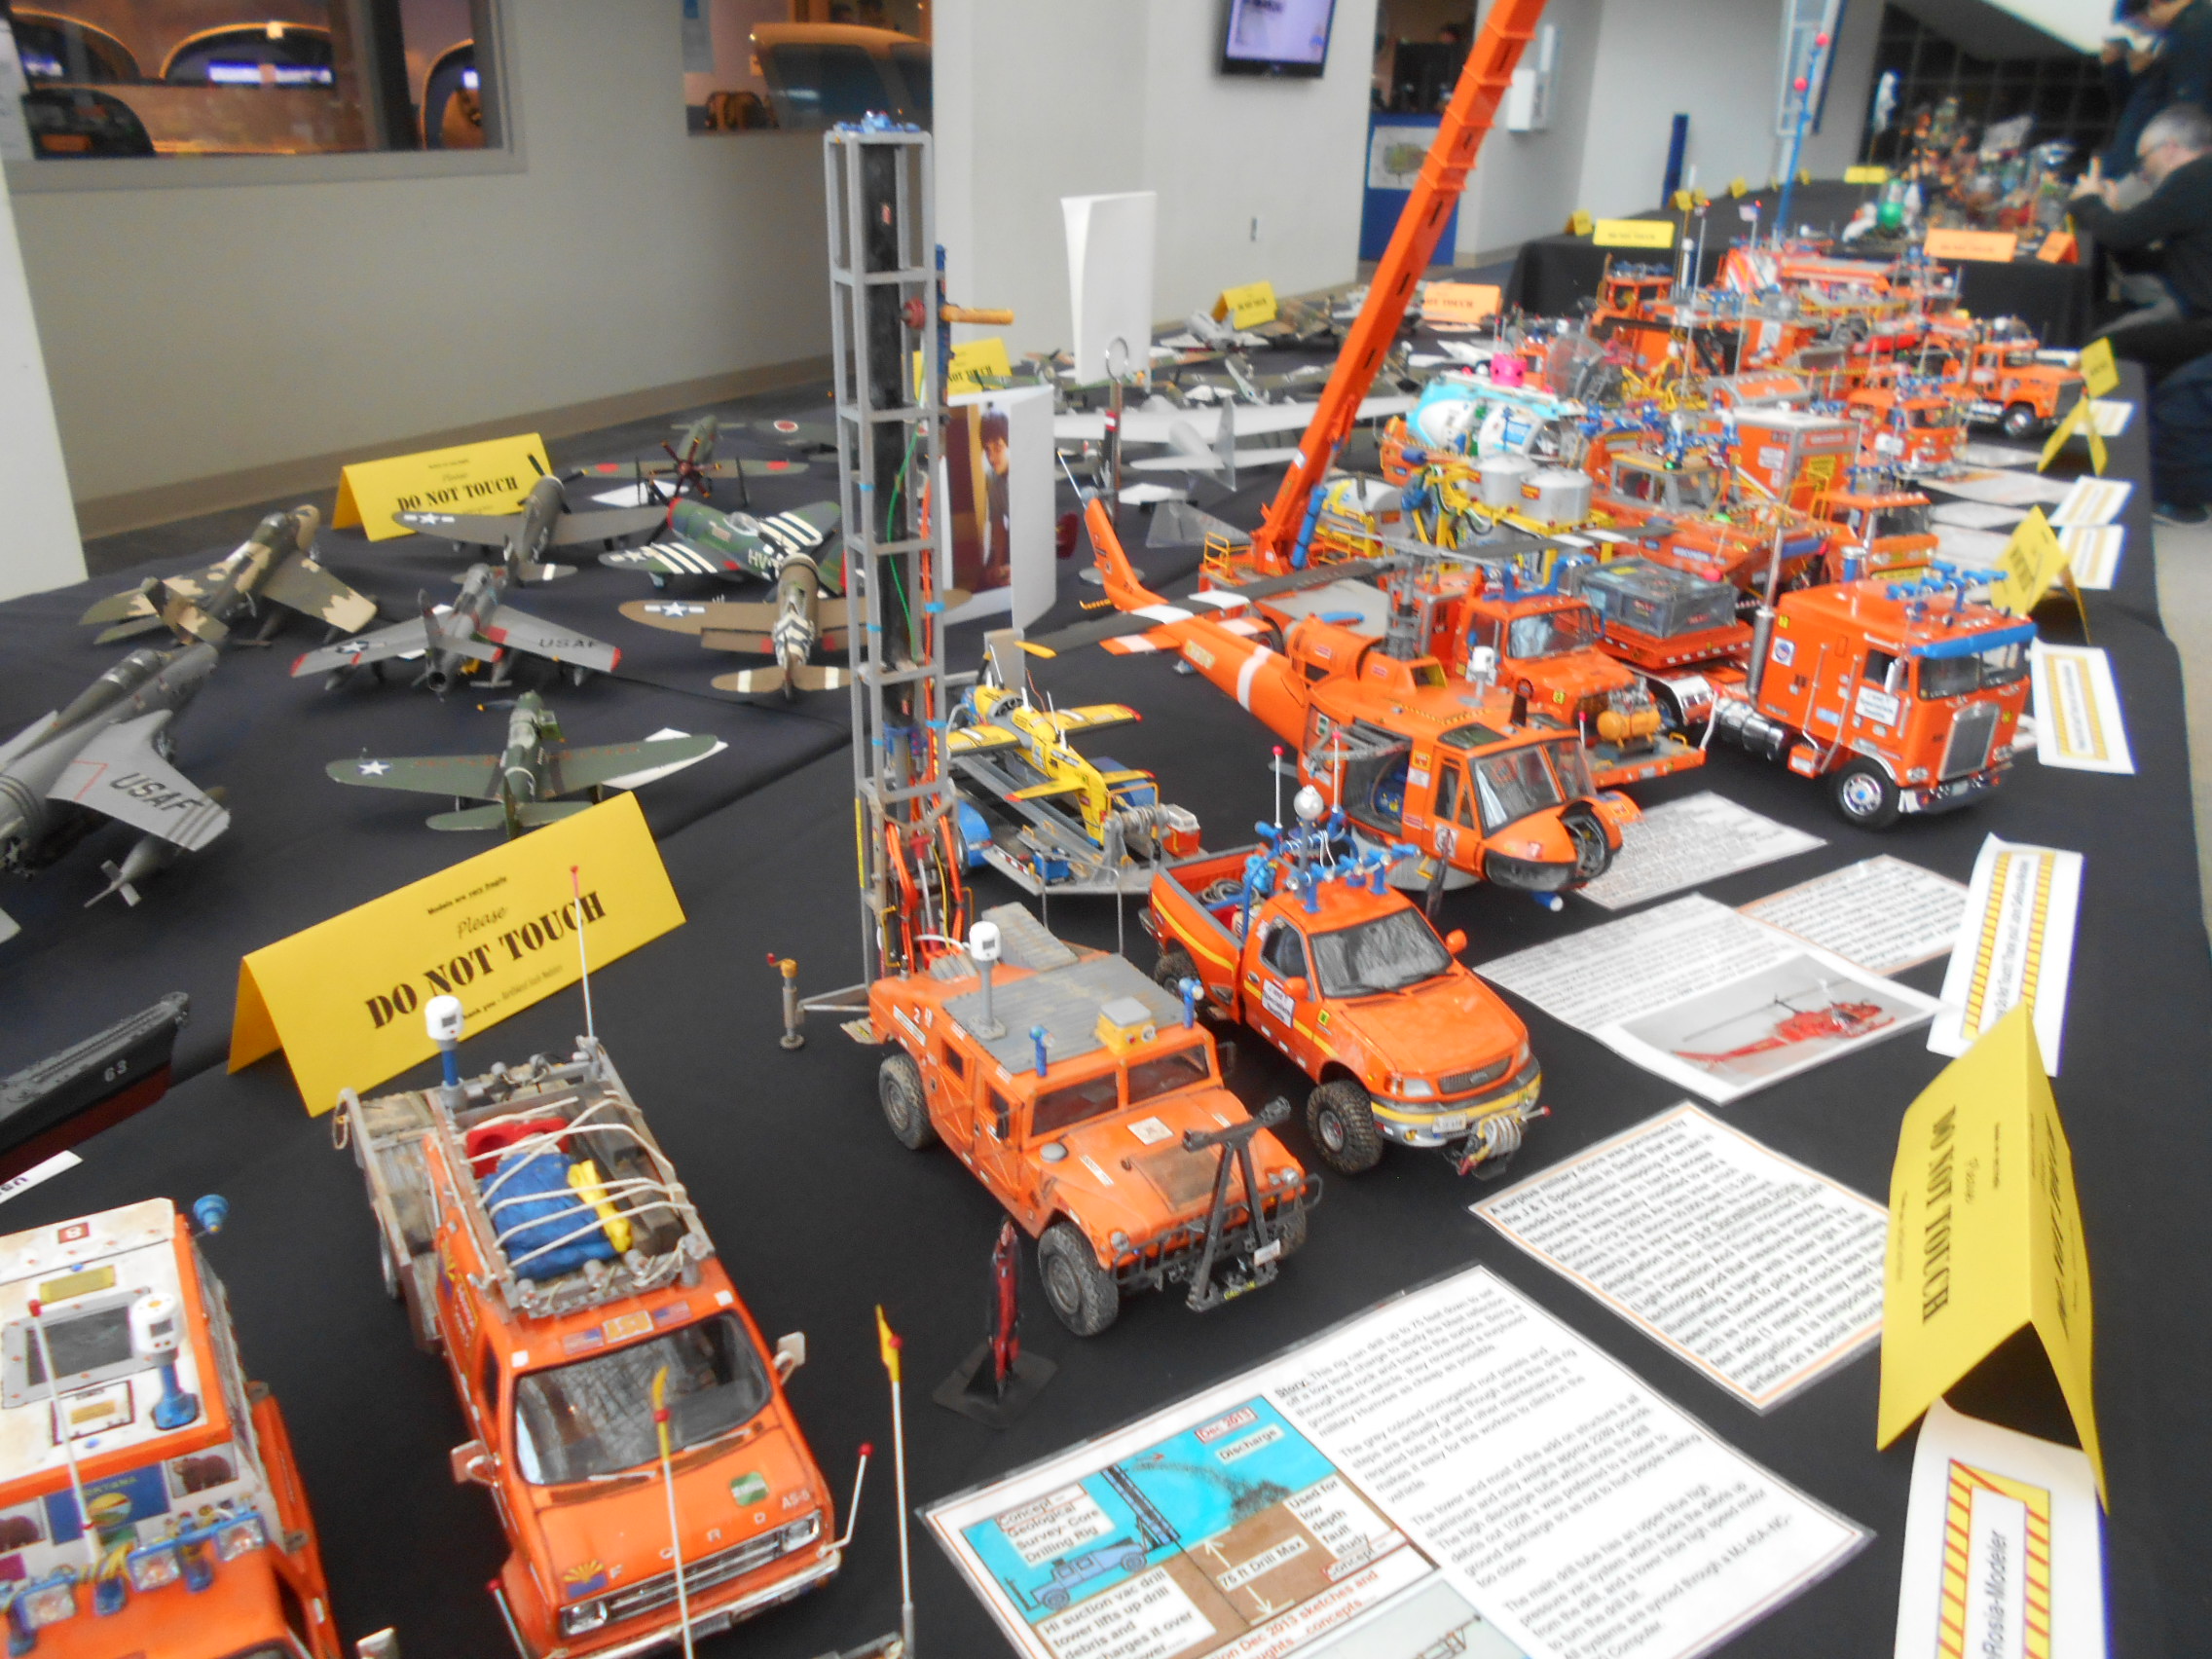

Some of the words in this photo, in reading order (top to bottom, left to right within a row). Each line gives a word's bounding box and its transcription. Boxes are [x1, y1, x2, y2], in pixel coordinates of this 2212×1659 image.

[397, 495, 421, 511] DO
[425, 488, 460, 506] NOT
[463, 476, 519, 498] TOUCH
[537, 639, 598, 650] USAF
[109, 772, 205, 811] USAF
[457, 905, 509, 940] Please
[365, 983, 419, 1029] DO
[424, 944, 494, 997] NOT
[498, 891, 607, 961] TOUCH
[104, 1059, 128, 1083] 63
[1930, 1104, 1957, 1151] DO
[1926, 1144, 1954, 1208] NOT
[1923, 1204, 1951, 1324] TOUCH
[1195, 1420, 1219, 1439] Dec
[1221, 1408, 1250, 1427] 2013
[1216, 1430, 1275, 1461] Discharge
[1288, 1489, 1320, 1508] Used
[1319, 1480, 1338, 1493] for
[1004, 1501, 1075, 1538] Geological
[1299, 1505, 1322, 1520] low
[1311, 1510, 1346, 1531] depth
[1021, 1537, 1075, 1566] Drilling
[1073, 1526, 1099, 1540] Rig
[1321, 1524, 1349, 1543] fault
[1335, 1532, 1370, 1557] study
[1217, 1573, 1236, 1588] 75
[1236, 1567, 1249, 1578] ft
[1248, 1553, 1275, 1571] Drill
[1275, 1541, 1302, 1557] Max
[1043, 1622, 1059, 1635] Hi
[1062, 1598, 1113, 1626] suction
[1114, 1586, 1134, 1600] vac
[1139, 1569, 1165, 1587] drill
[1052, 1624, 1091, 1647] tower
[1093, 1611, 1122, 1628] lifts
[1123, 1602, 1142, 1614] up
[1142, 1585, 1168, 1604] drill
[1162, 1611, 1193, 1630] over
